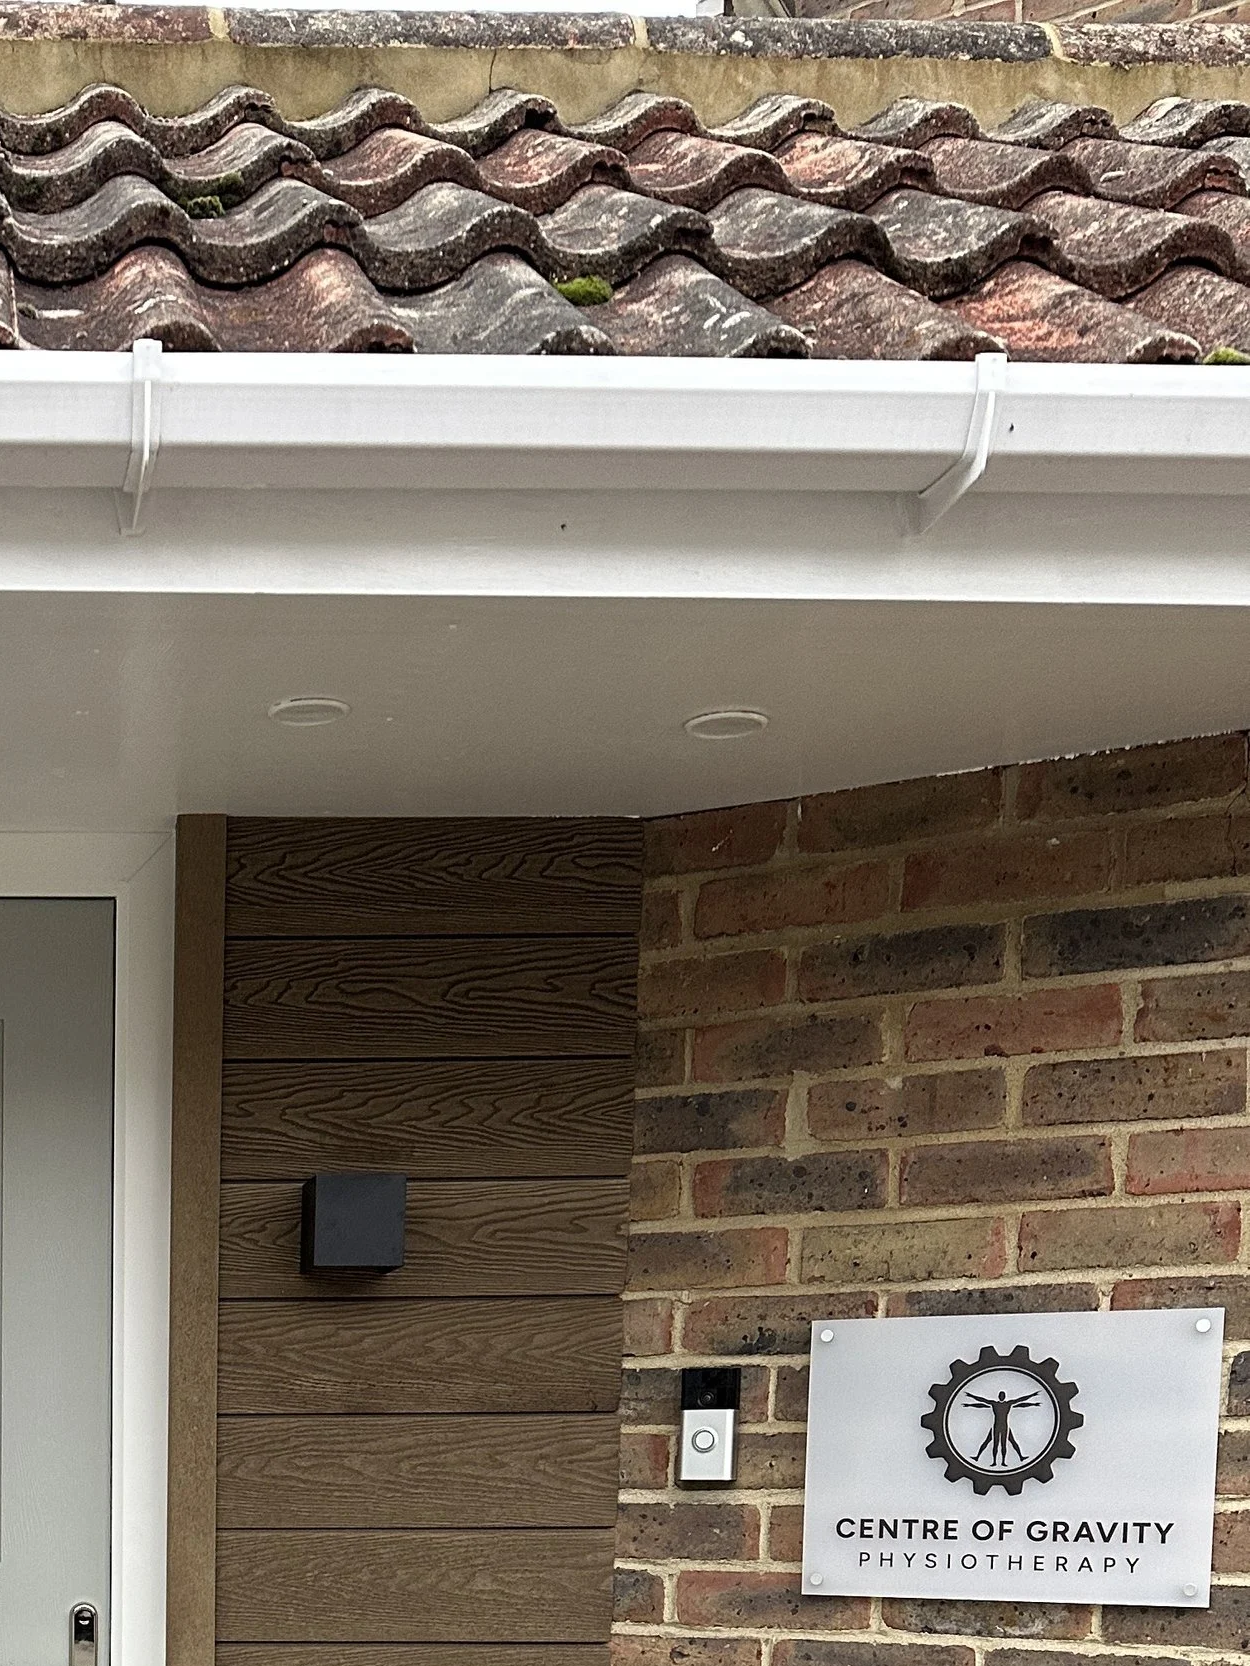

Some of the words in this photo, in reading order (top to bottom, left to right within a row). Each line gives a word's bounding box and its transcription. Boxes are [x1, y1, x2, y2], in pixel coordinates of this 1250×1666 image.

[835, 1517, 959, 1541] CENTRE
[971, 1519, 1014, 1542] OF
[1026, 1520, 1174, 1545] GRAVITY
[859, 1551, 1141, 1574] PHYSIOTHERAPY
